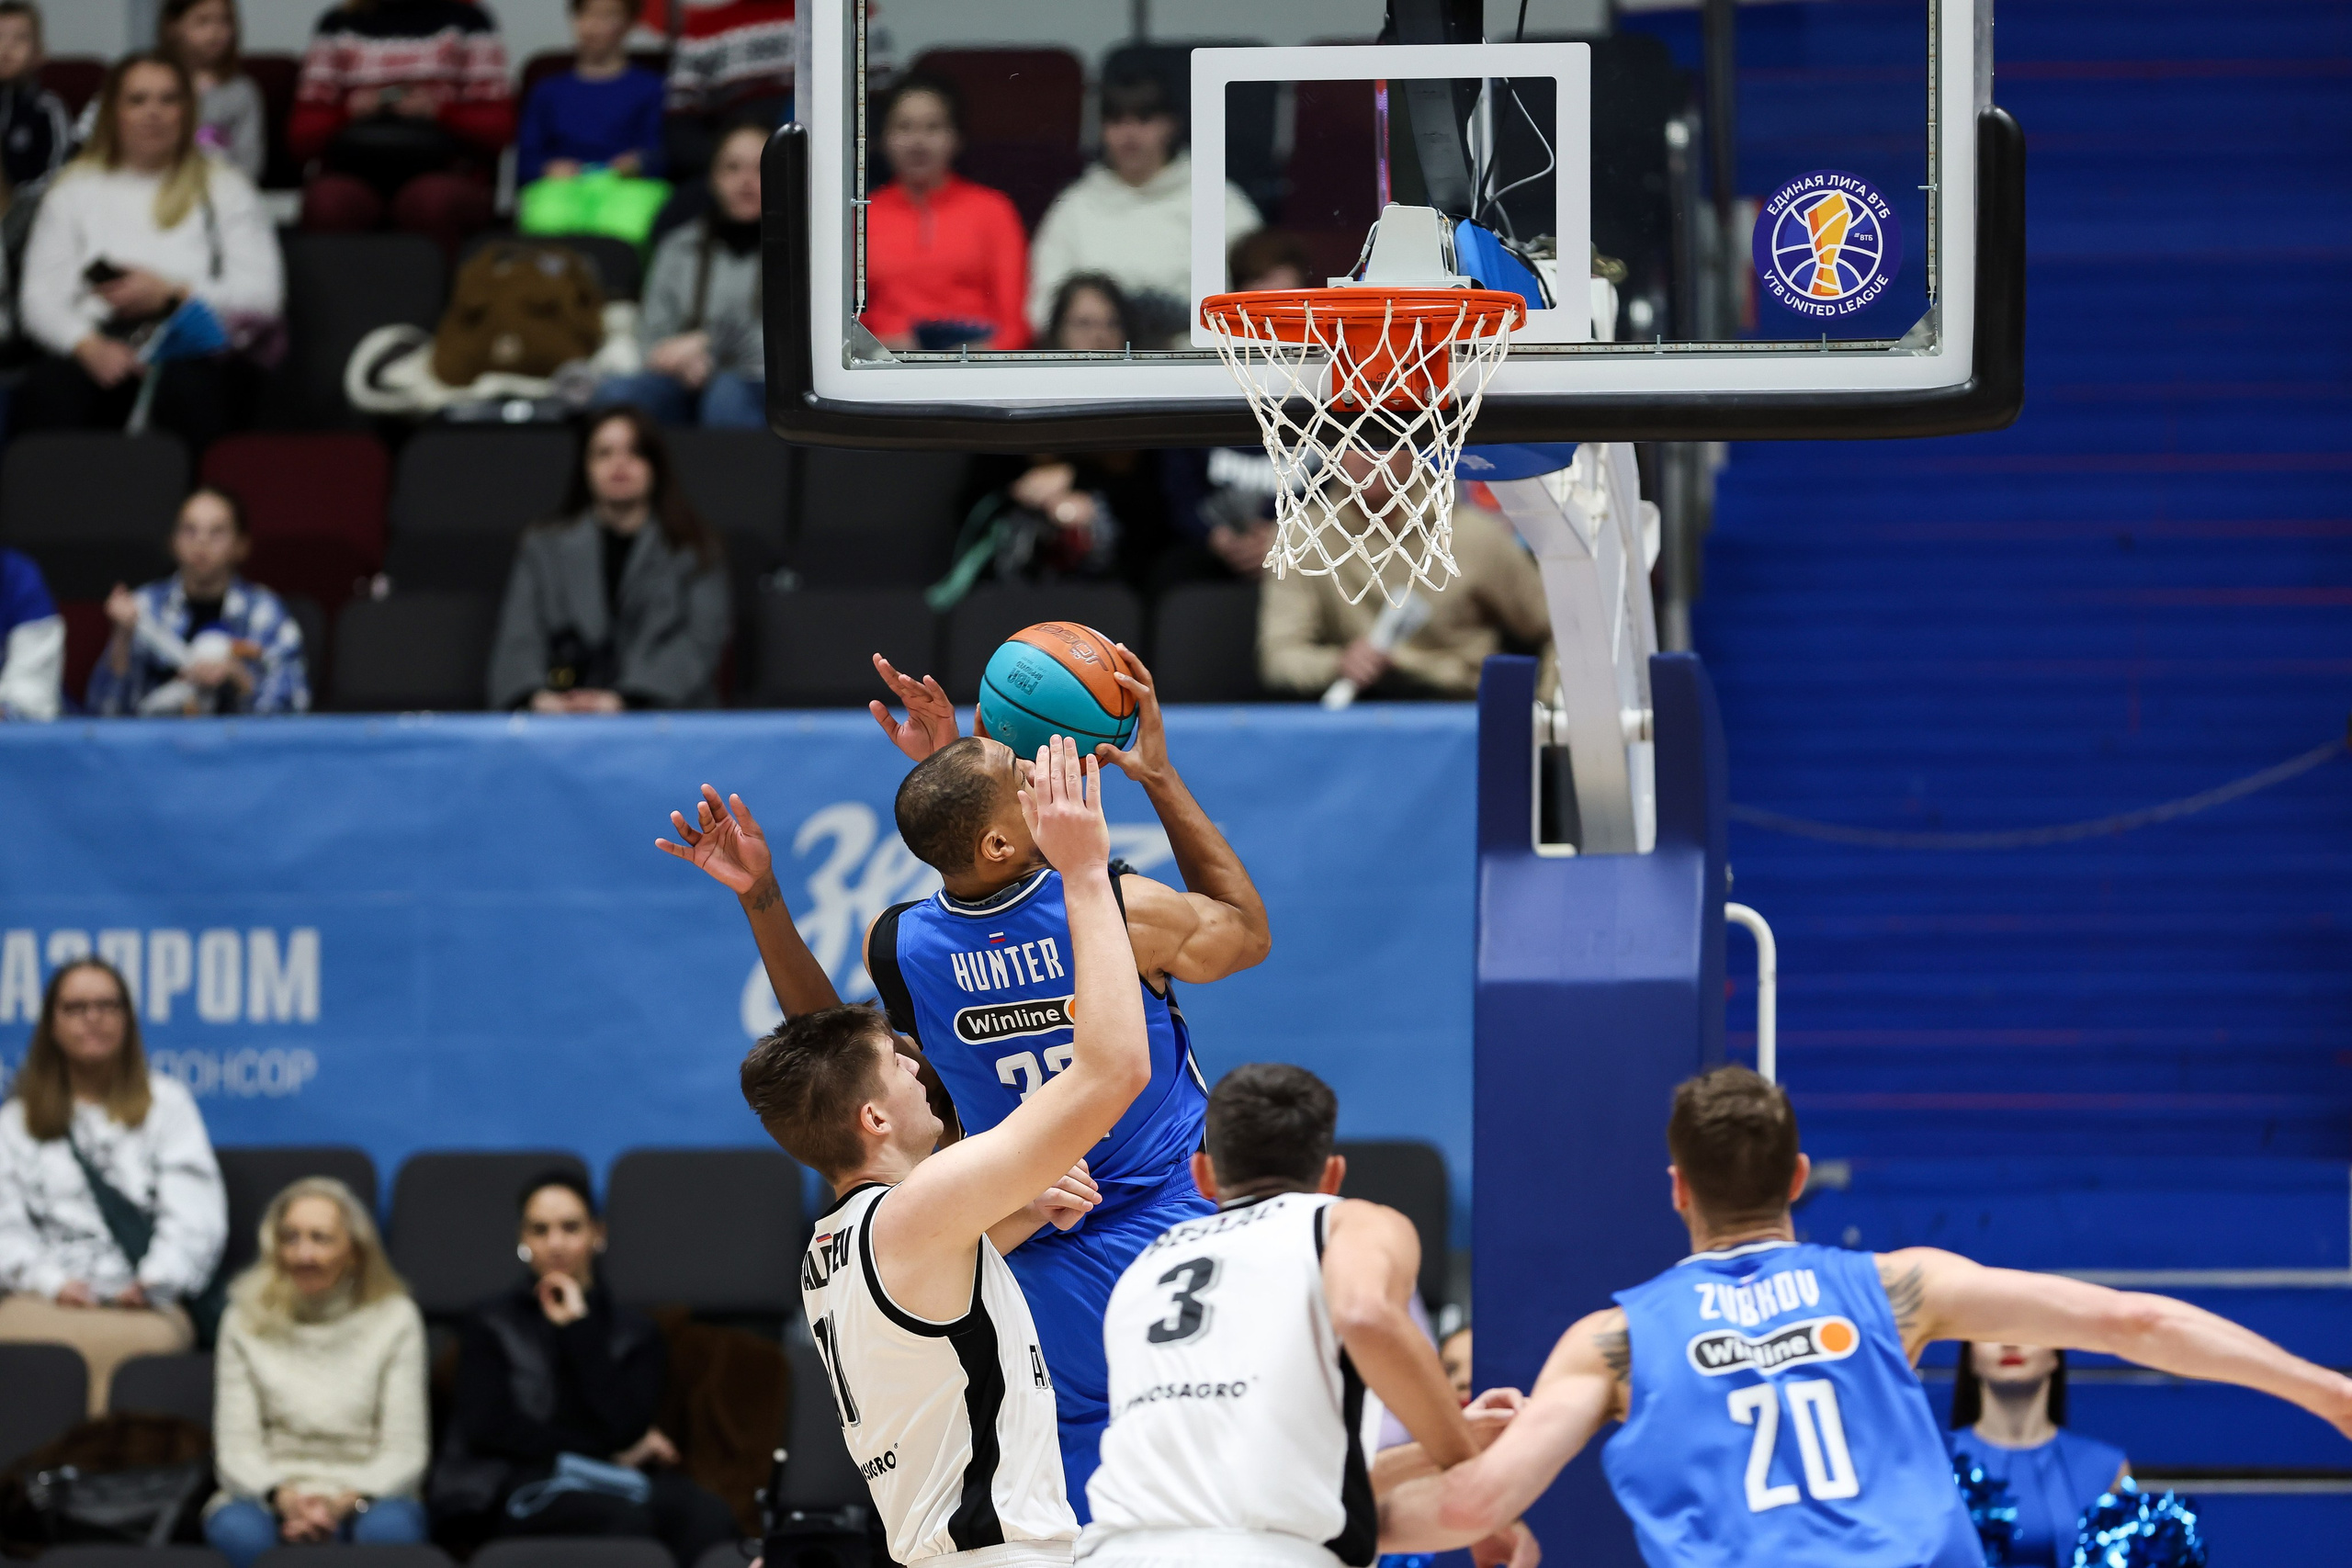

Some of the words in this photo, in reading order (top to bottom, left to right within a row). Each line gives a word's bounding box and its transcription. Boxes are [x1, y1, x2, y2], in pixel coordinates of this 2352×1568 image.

[1766, 175, 1824, 216] ЕДИНАЯ
[1827, 175, 1867, 197] ЛИГА
[1867, 192, 1891, 220] ВТБ
[1763, 269, 1784, 297] VTB
[1783, 292, 1836, 316] UNITED
[1838, 274, 1890, 314] LEAGUE
[1007, 667, 1039, 696] FIBA
[950, 937, 1065, 992] HUNTER
[966, 1007, 1061, 1034] Winline
[1148, 1257, 1217, 1344] 3
[1694, 1269, 1821, 1327] ZUBKOV
[1726, 1378, 1860, 1514] 20
